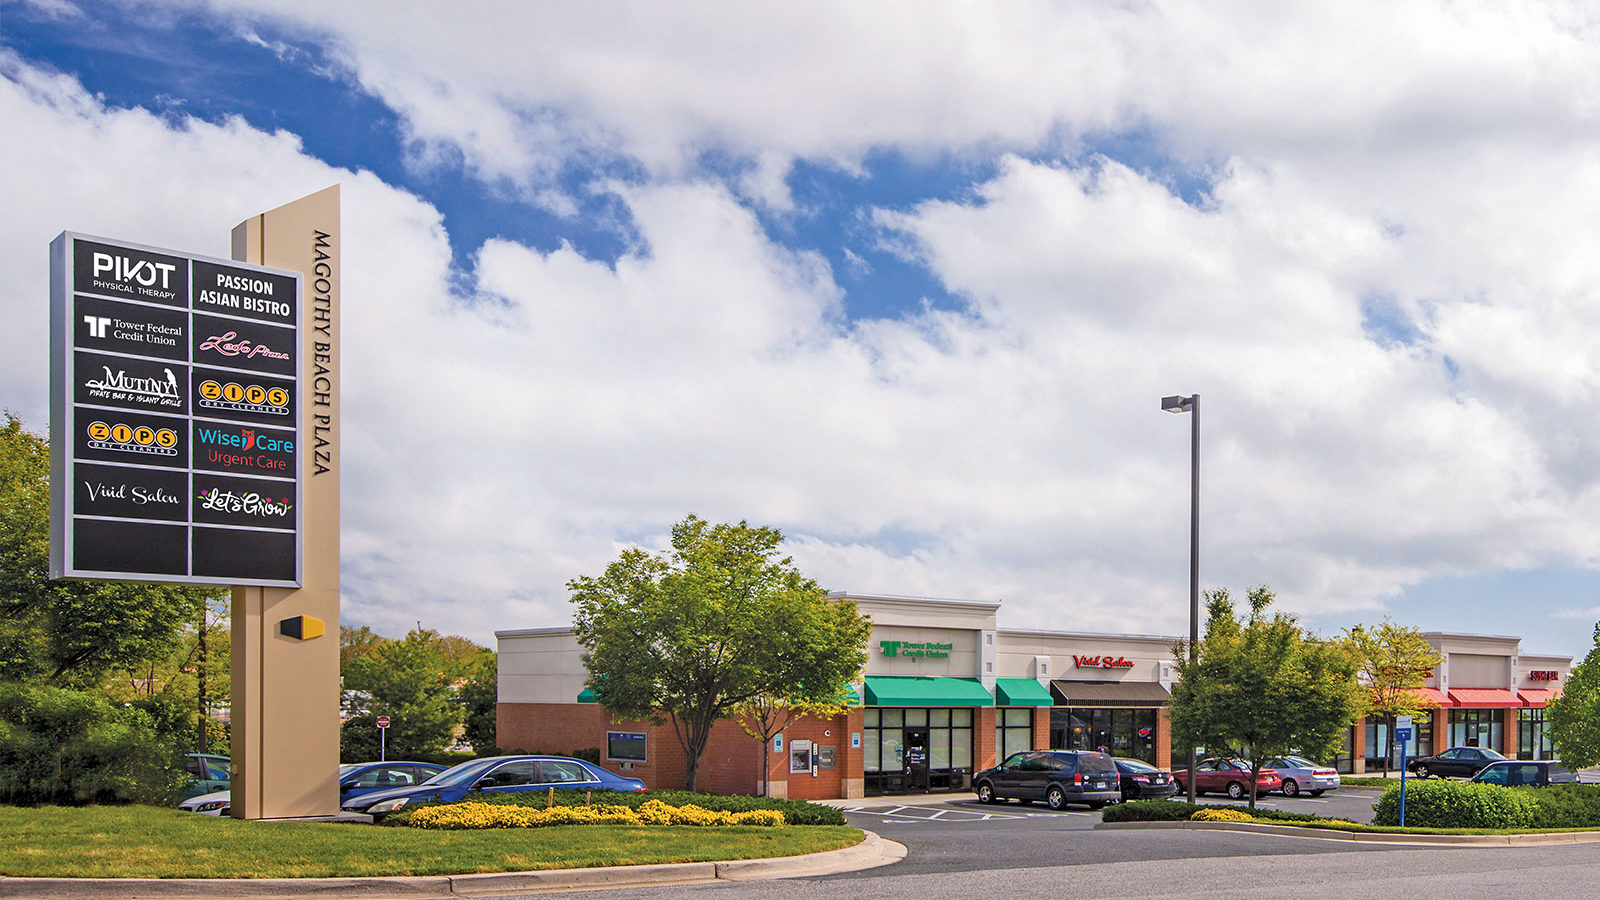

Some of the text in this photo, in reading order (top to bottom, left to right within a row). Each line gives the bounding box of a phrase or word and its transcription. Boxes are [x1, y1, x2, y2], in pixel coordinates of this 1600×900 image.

[93, 252, 176, 289] PIVOT
[93, 280, 176, 300] PHYSICAL THERAPY
[216, 273, 273, 296] PASSION
[199, 289, 290, 317] ASIAN BISTRO
[113, 318, 182, 336] Tower Federal
[113, 329, 176, 346] Credit Union
[313, 229, 331, 476] MAGOTHY BEACH PLAZA
[89, 389, 182, 408] PIRATE BAR & ISLAND GRILLE
[201, 382, 287, 407] ZIPS
[90, 423, 175, 447] ZIPS
[198, 428, 294, 453] Wise Care
[208, 449, 287, 470] Urgent Care
[84, 481, 180, 505] Vivid Salon
[202, 487, 290, 517] Let's Grow
[1102, 655, 1135, 669] Salon
